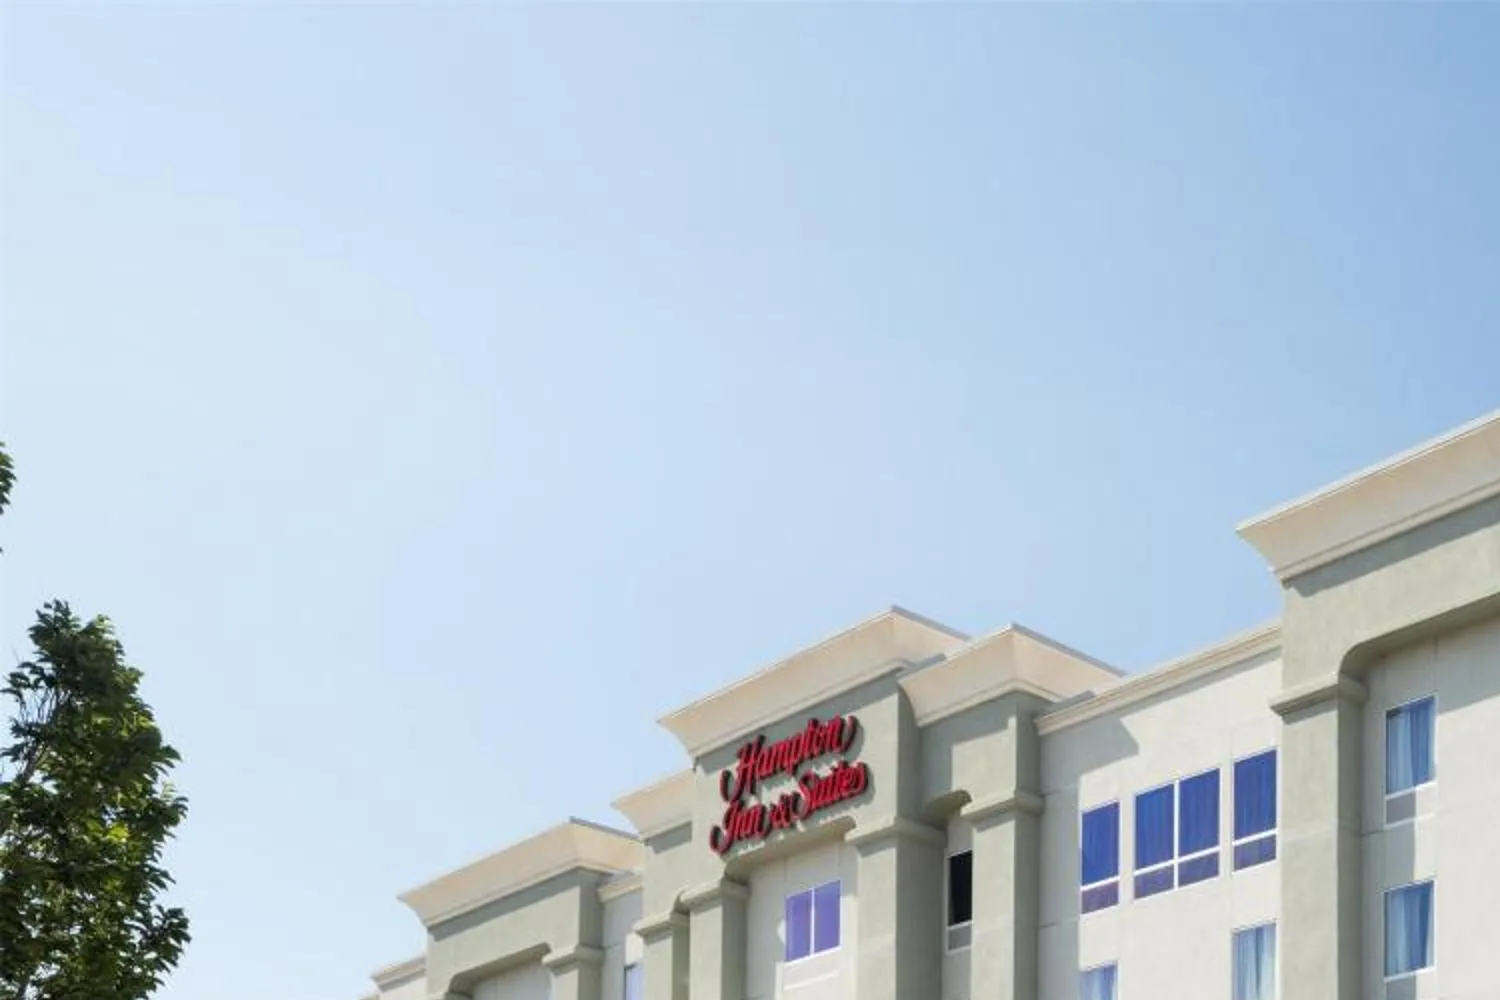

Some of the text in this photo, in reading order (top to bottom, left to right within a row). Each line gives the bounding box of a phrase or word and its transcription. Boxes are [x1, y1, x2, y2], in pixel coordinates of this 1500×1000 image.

[720, 712, 859, 802] Hampton
[709, 800, 770, 856] Inn
[790, 761, 869, 821] Suites
